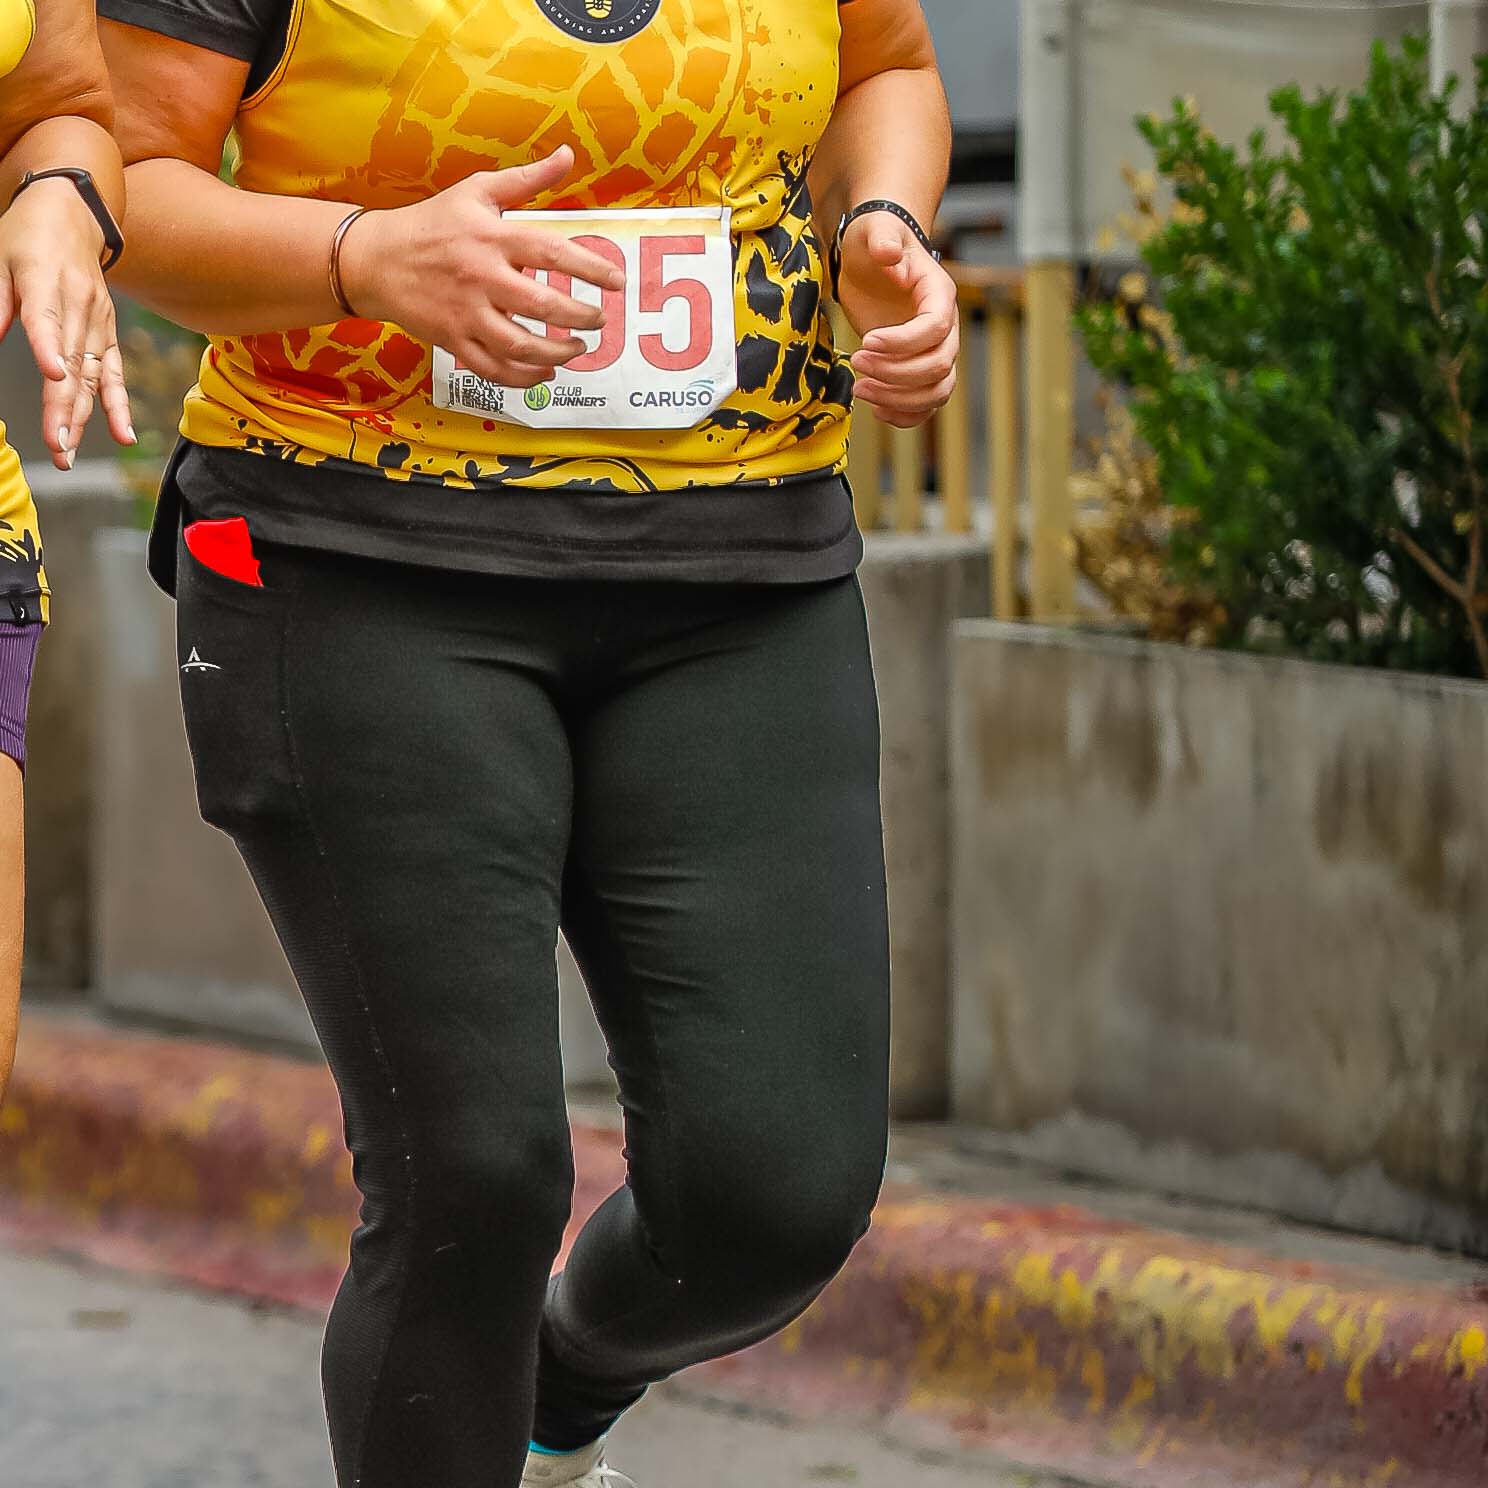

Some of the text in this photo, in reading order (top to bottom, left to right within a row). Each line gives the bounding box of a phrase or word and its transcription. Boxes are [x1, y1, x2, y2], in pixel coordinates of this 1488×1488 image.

[455, 235, 712, 372] 05
[553, 386, 583, 397] CLUB
[629, 391, 712, 408] CARUSO
